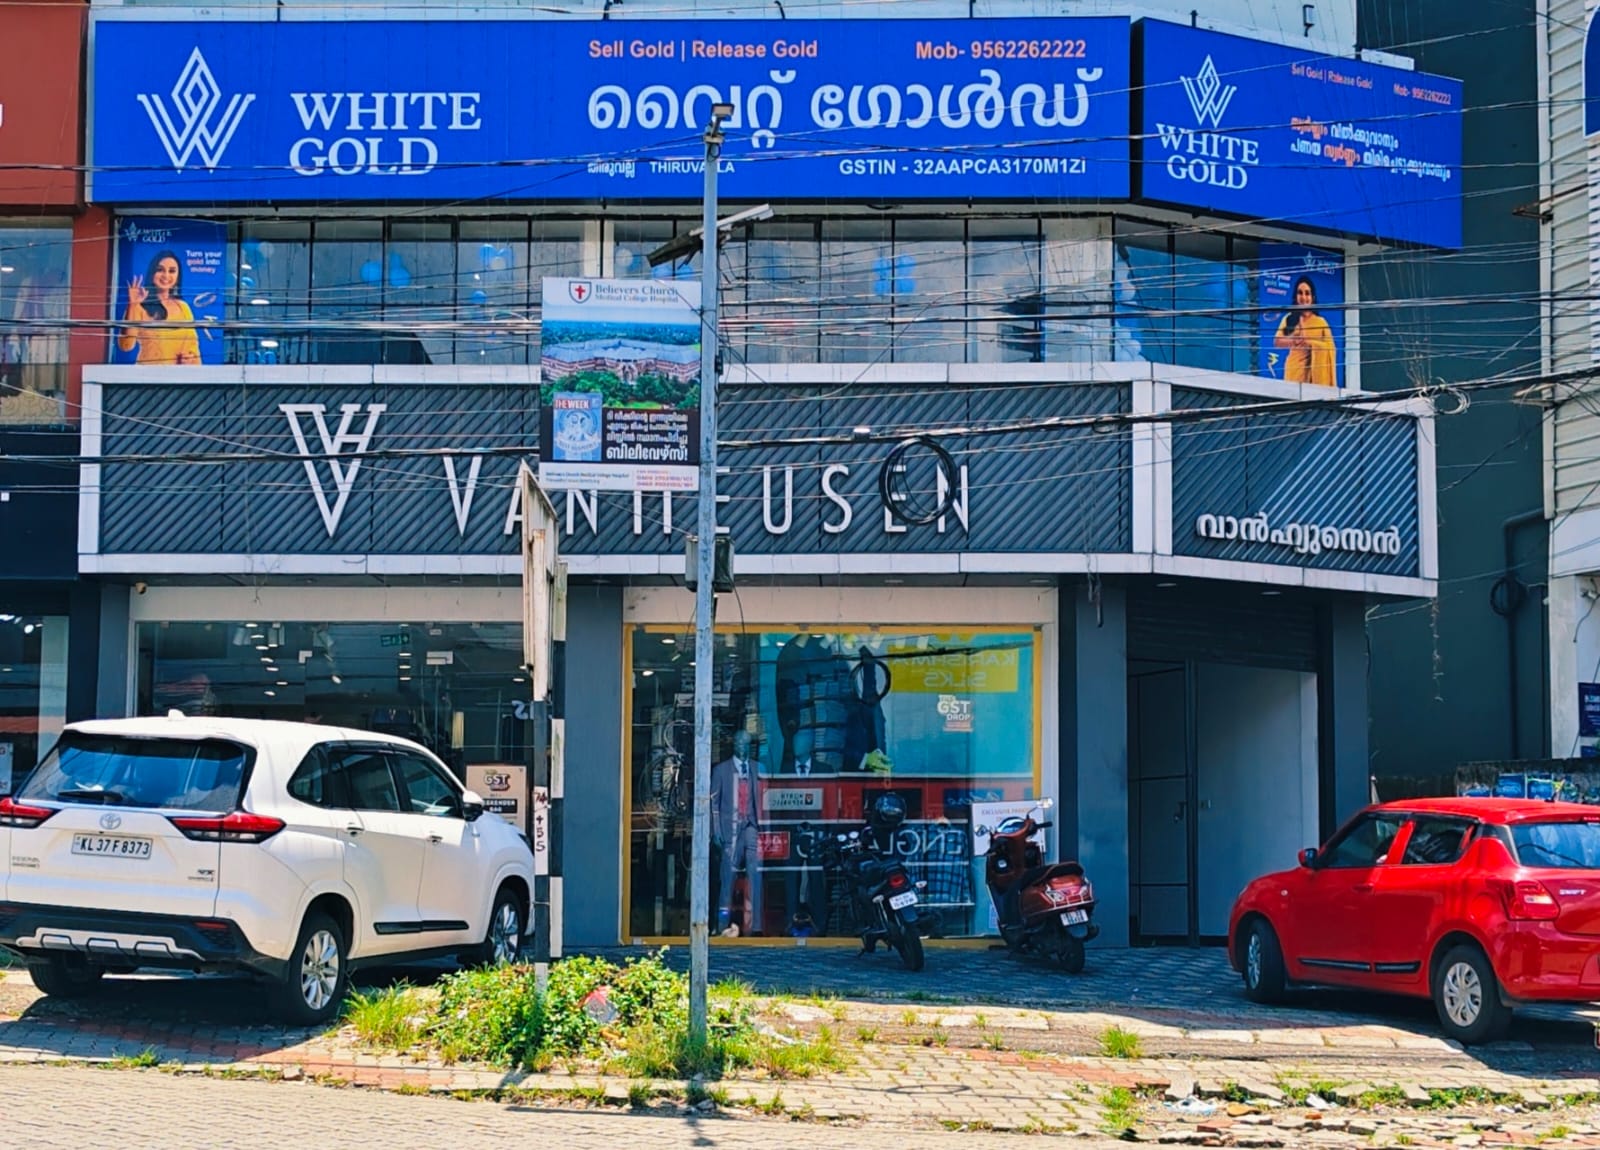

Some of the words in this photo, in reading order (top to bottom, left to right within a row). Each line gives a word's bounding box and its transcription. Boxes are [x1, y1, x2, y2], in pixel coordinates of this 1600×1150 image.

[589, 40, 624, 58] Sell
[630, 40, 674, 58] Gold
[692, 40, 766, 58] Release
[773, 40, 818, 58] Gold
[916, 41, 965, 59] Mob-
[970, 40, 1086, 58] 9562262222
[290, 92, 482, 131] WHITE
[1155, 122, 1260, 166] WHITE
[289, 137, 439, 176] GOLD
[839, 158, 896, 174] GSTIN
[1167, 154, 1249, 190] GOLD
[595, 284, 639, 294] Believers
[641, 284, 679, 297] Church
[80, 837, 94, 851] KL
[96, 839, 111, 852] 37
[112, 840, 120, 853] F
[121, 840, 150, 855] 8373
